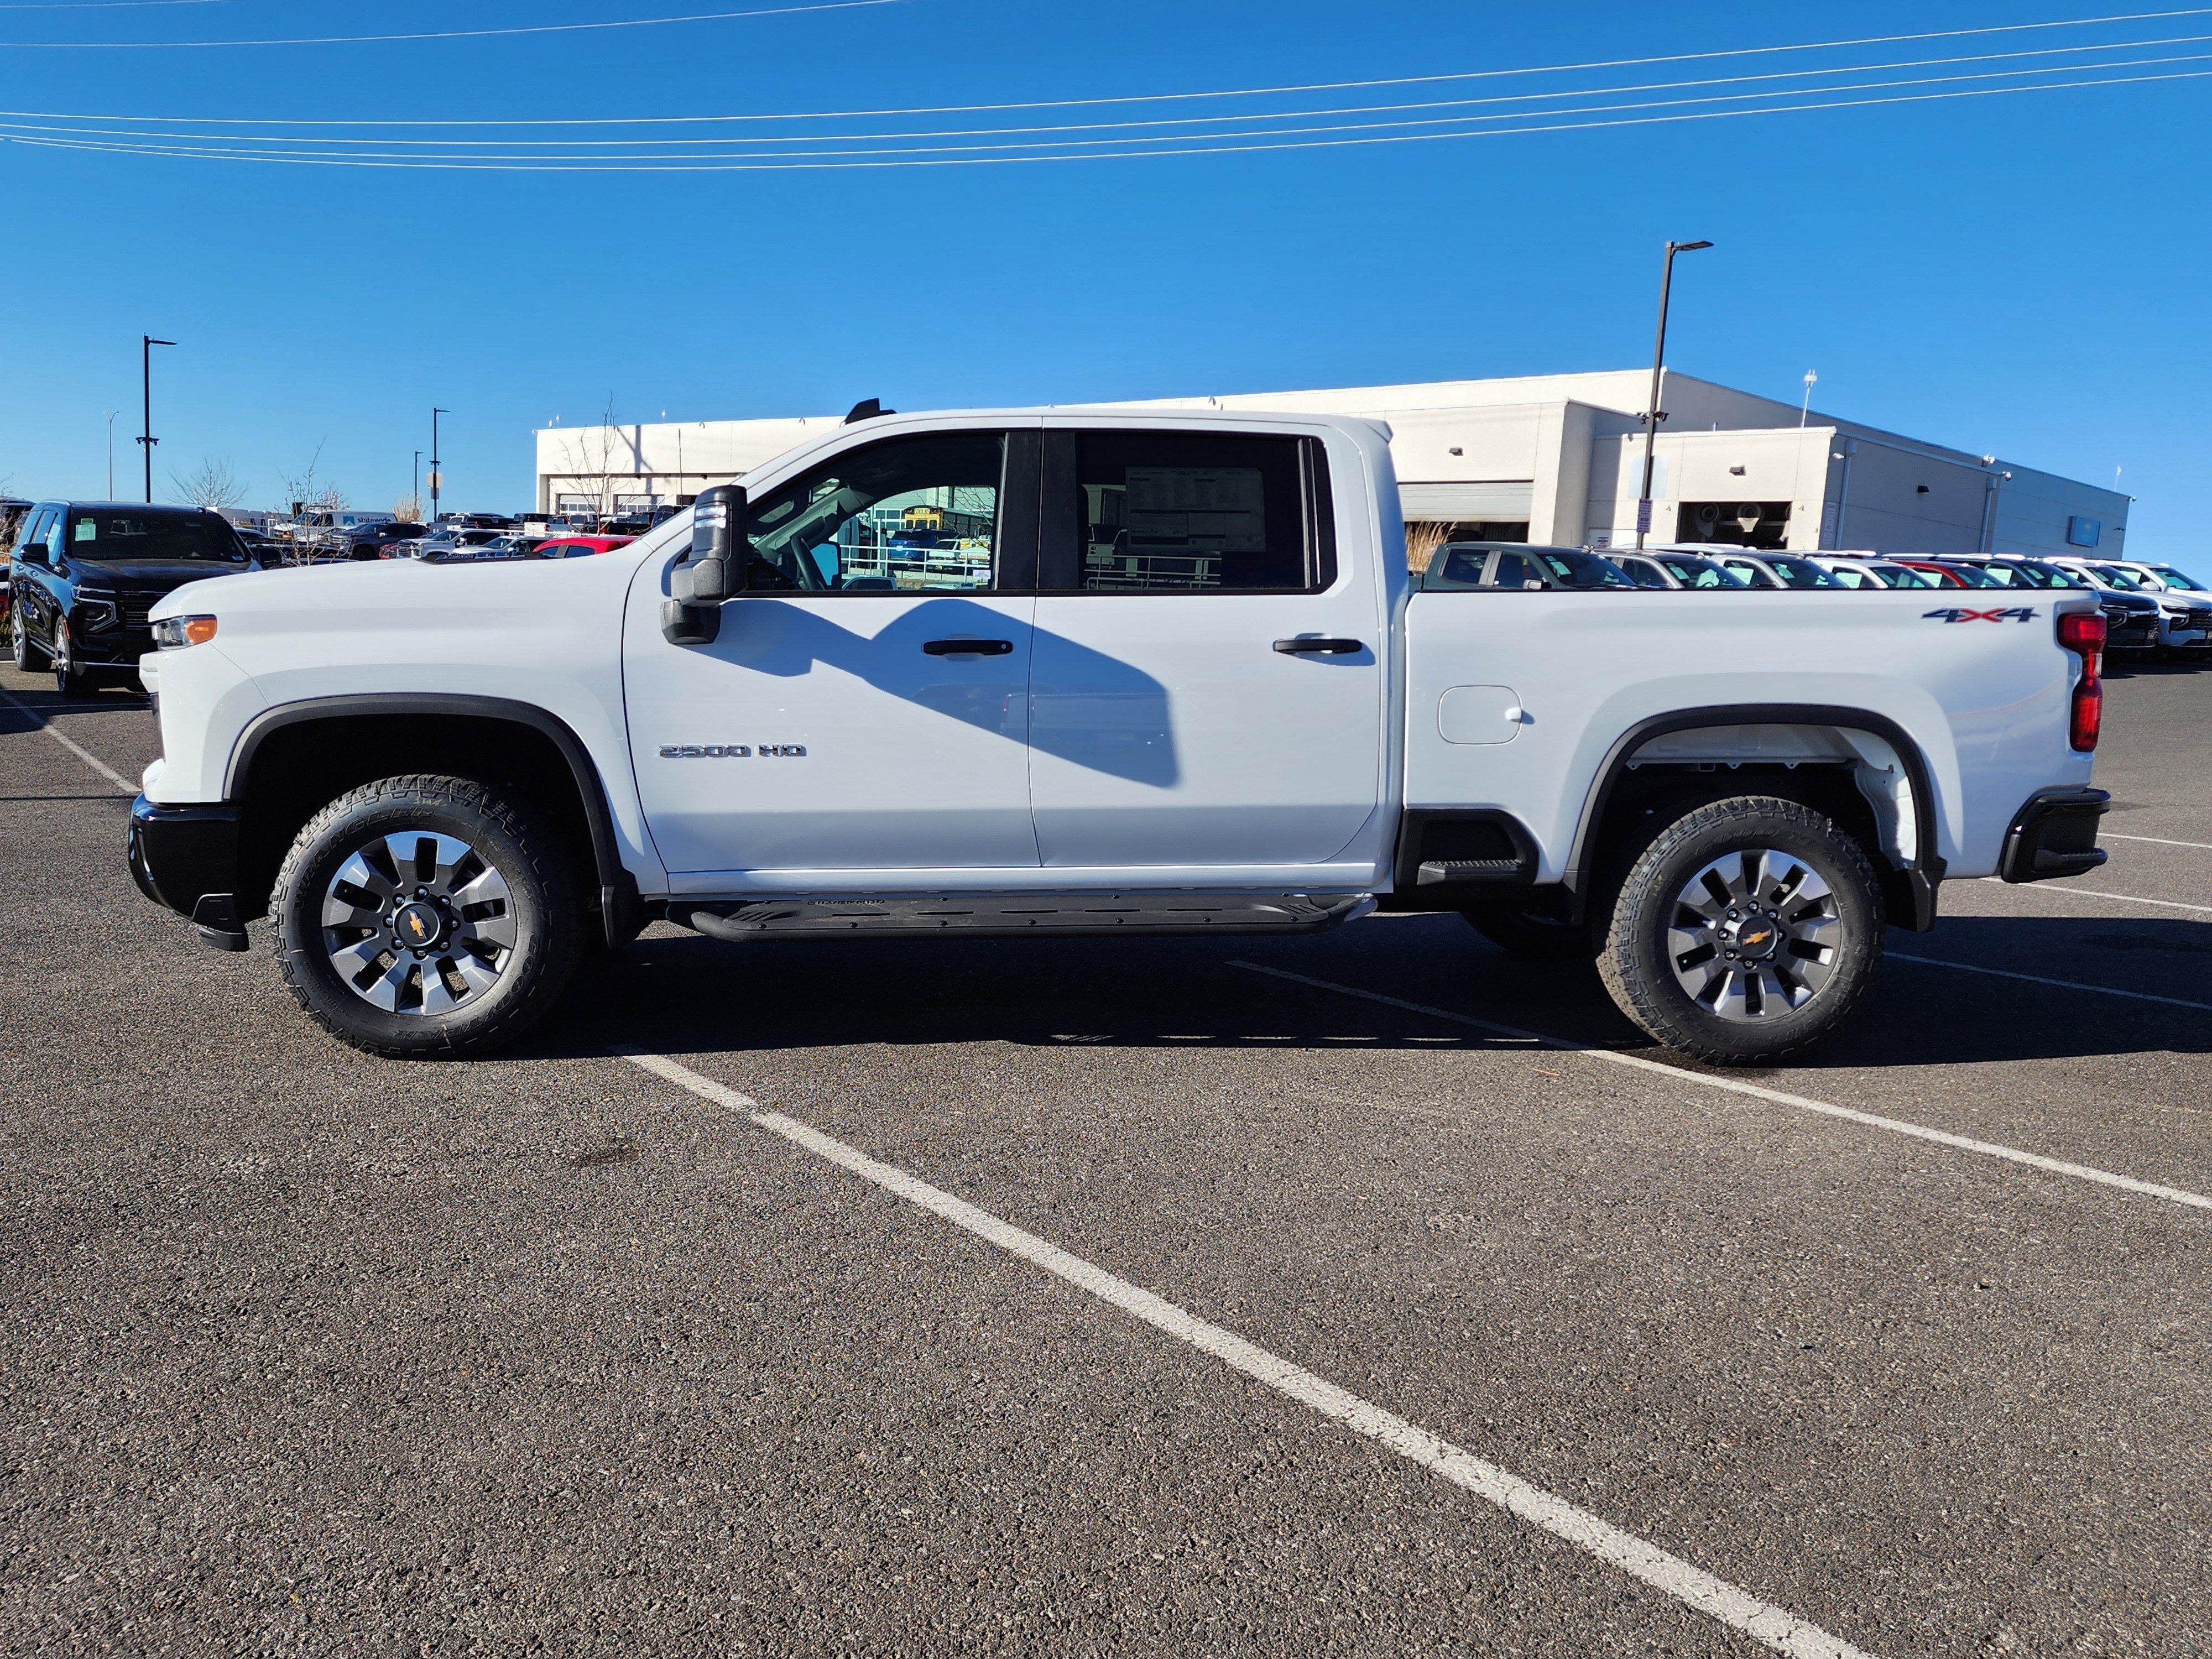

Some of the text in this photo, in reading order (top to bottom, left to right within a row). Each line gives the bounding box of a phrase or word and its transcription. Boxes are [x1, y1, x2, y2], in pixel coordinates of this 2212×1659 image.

[658, 744, 803, 758] 2500 HD
[293, 806, 435, 910] WRANGLER
